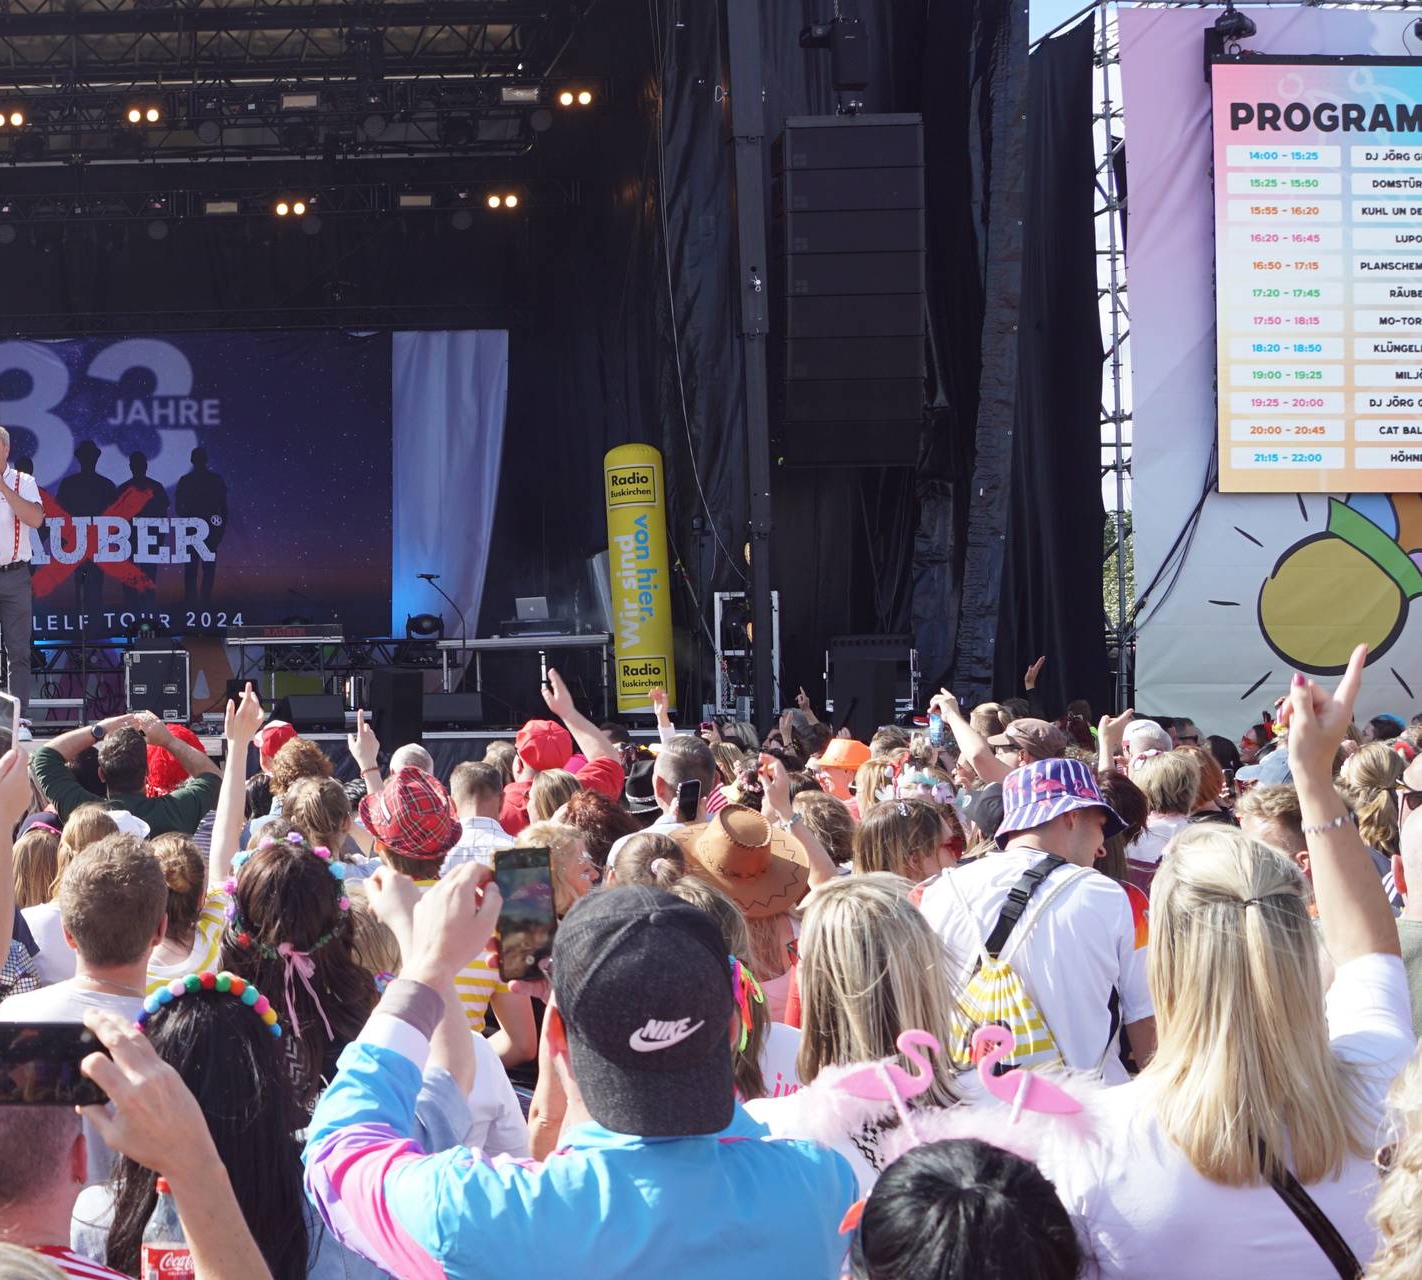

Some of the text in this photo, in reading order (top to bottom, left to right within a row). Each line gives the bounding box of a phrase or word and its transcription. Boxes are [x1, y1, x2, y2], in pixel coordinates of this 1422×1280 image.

[1249, 151, 1278, 160] 14:00
[1291, 151, 1319, 160] 15:25
[1365, 152, 1378, 161] DJ
[1382, 149, 1410, 161] JÖRG
[1250, 179, 1277, 188] 15:25
[1290, 179, 1319, 188] 15:50
[1250, 206, 1278, 215] 15:55
[1291, 206, 1319, 215] 16:20
[1361, 207, 1388, 215] KUHL
[1392, 207, 1407, 215] UN
[1250, 234, 1279, 243] 16:20
[1291, 234, 1321, 243] 16:45
[1252, 262, 1282, 270] 16:50
[1294, 262, 1319, 270] 17:15
[1252, 289, 1280, 298] 17:20
[1293, 289, 1321, 298] 17:45
[1253, 316, 1282, 325] 17:50
[1294, 316, 1320, 325] 18:15
[1252, 344, 1280, 352] 18:20
[1293, 344, 1322, 352] 18:50
[1373, 341, 1422, 353] KLÜNGEL
[1252, 371, 1282, 379] 19:00
[1294, 371, 1322, 379] 19:25
[1251, 398, 1279, 407] 19:25
[1292, 398, 1324, 407] 20:00
[1369, 399, 1382, 407] DJ
[1386, 395, 1414, 407] JÖRG
[108, 399, 221, 425] JAHRE
[1250, 426, 1282, 434] 20:00
[1294, 426, 1326, 434] 20:45
[1379, 426, 1399, 435] CAT
[1254, 453, 1278, 462] 21:15
[1291, 453, 1322, 462] 22:00
[611, 472, 649, 487] Radio
[610, 488, 652, 498] Euskirchen
[634, 514, 659, 622] von hier.
[614, 535, 642, 649] Wir sind
[186, 612, 243, 628] 2024
[623, 663, 661, 677] Radio
[622, 678, 664, 688] Euskirchen
[641, 1017, 691, 1041] NIKE
